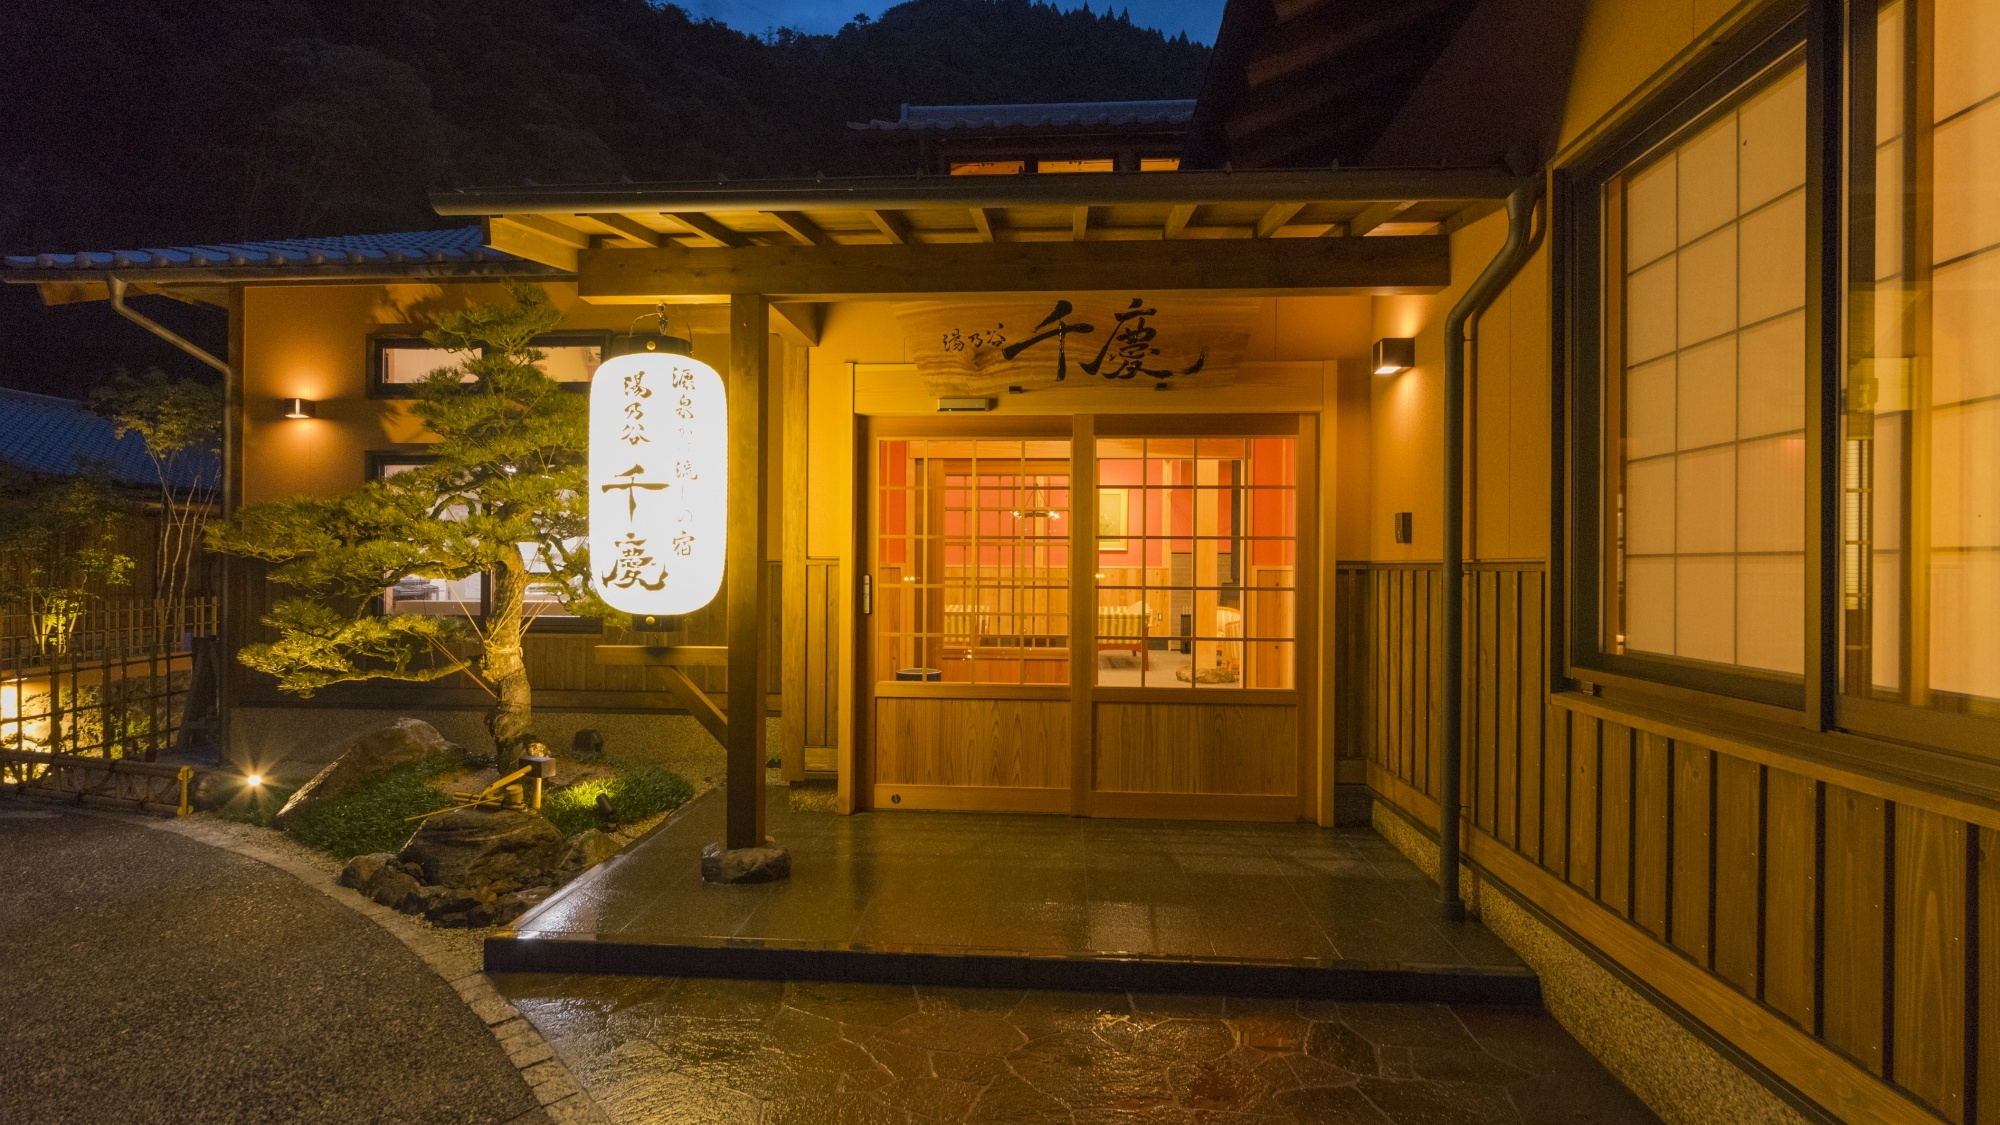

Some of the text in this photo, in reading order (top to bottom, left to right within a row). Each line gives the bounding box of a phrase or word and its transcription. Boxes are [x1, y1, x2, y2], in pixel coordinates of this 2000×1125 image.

[943, 298, 1206, 382] 湯乃谷 千慶
[601, 370, 671, 592] 湯乃谷 千慶
[671, 366, 698, 557] 源泉か流しの宿
